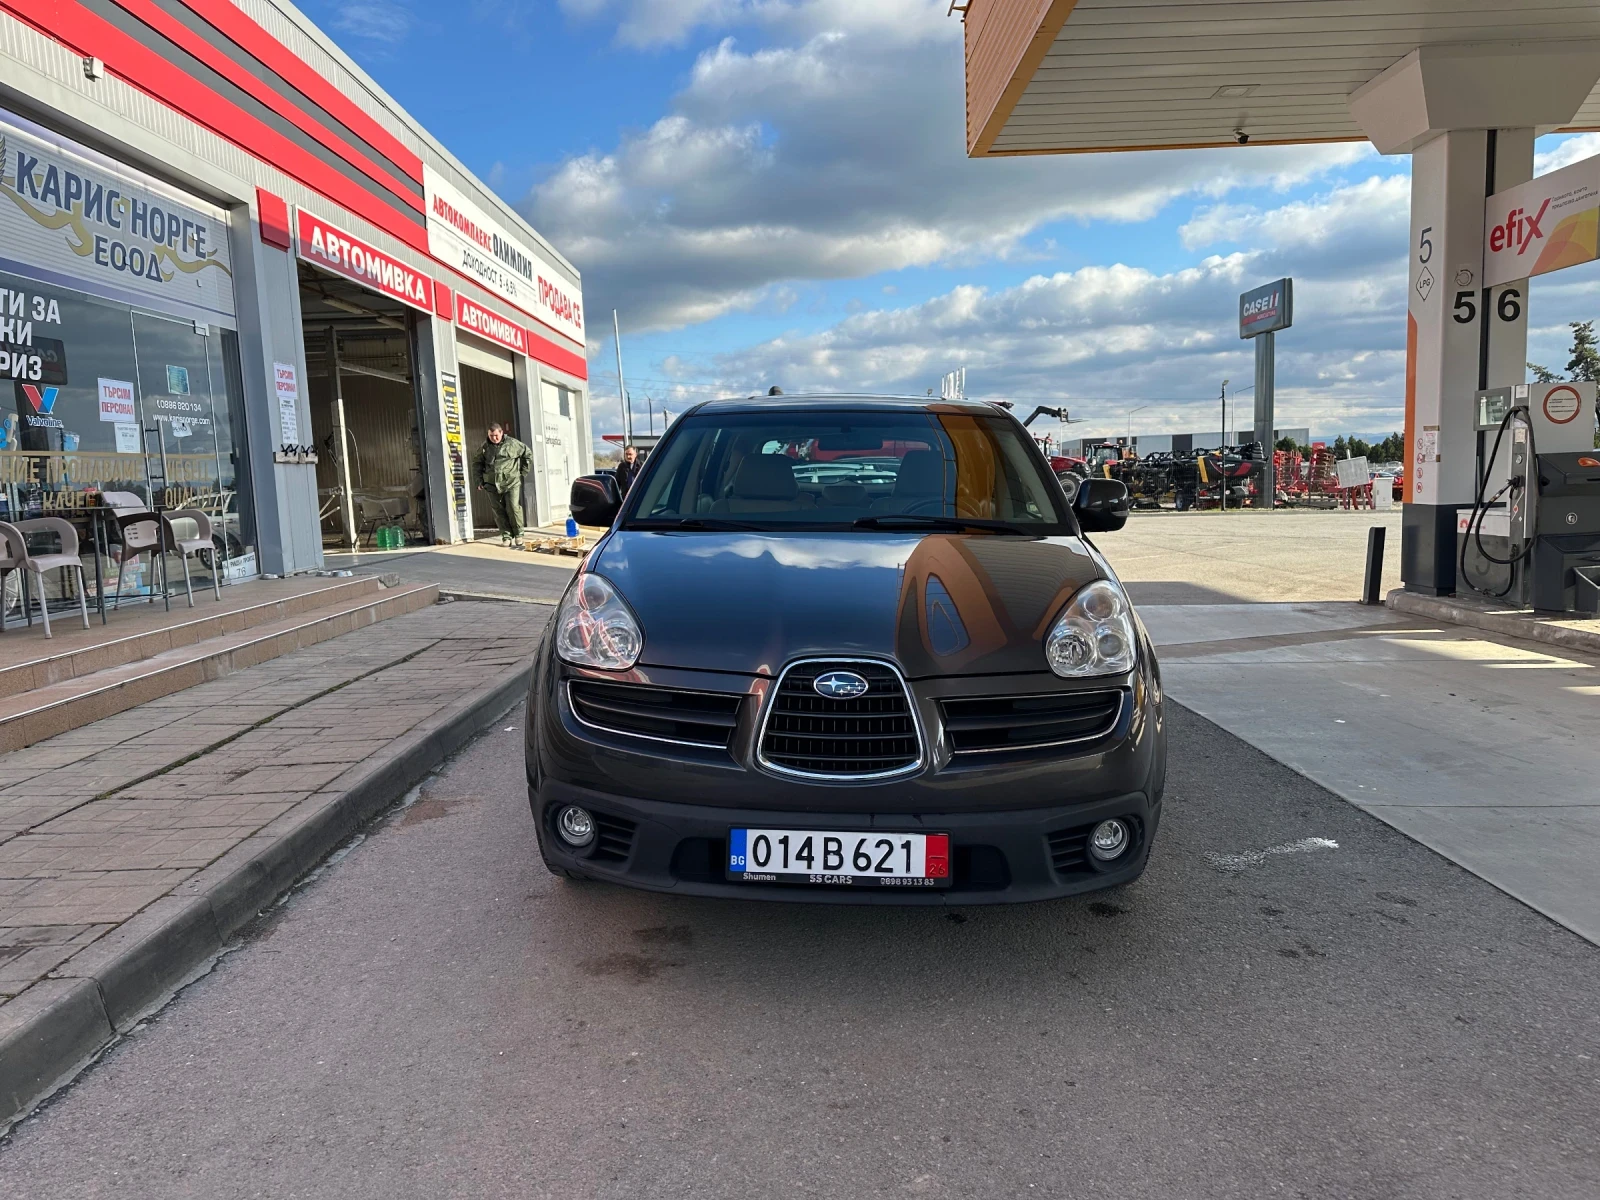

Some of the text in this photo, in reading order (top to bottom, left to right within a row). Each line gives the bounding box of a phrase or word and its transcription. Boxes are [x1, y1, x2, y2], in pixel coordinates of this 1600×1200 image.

[16, 151, 208, 259] КАРИС НОРГЕ
[433, 193, 533, 282] АВТОКОМПЛЕКС ОЛИМПИЯ
[1489, 197, 1552, 256] efix
[94, 235, 163, 283] ЕООД
[1418, 226, 1433, 264] 5
[310, 225, 427, 305] АВТОМИВКА
[462, 249, 498, 284] ДОХОДНОСТ
[1419, 278, 1431, 289] LPG
[32, 296, 62, 324] ЗА
[538, 275, 582, 330] ПРОДАВА СЕ
[1243, 296, 1269, 317] CASE
[1452, 290, 1476, 324] 5
[1497, 288, 1521, 322] 6
[462, 302, 524, 350] АВТОМИВКА
[103, 386, 131, 400] ТЪРСИМ
[46, 458, 144, 484] ПРОДАВАМЕ
[165, 485, 213, 508] QUALITY
[730, 854, 745, 866] BG
[928, 863, 946, 876] 26
[743, 872, 776, 882] Shumen
[810, 875, 853, 884] SS CARS
[902, 878, 913, 886] 93
[913, 878, 922, 886] 13
